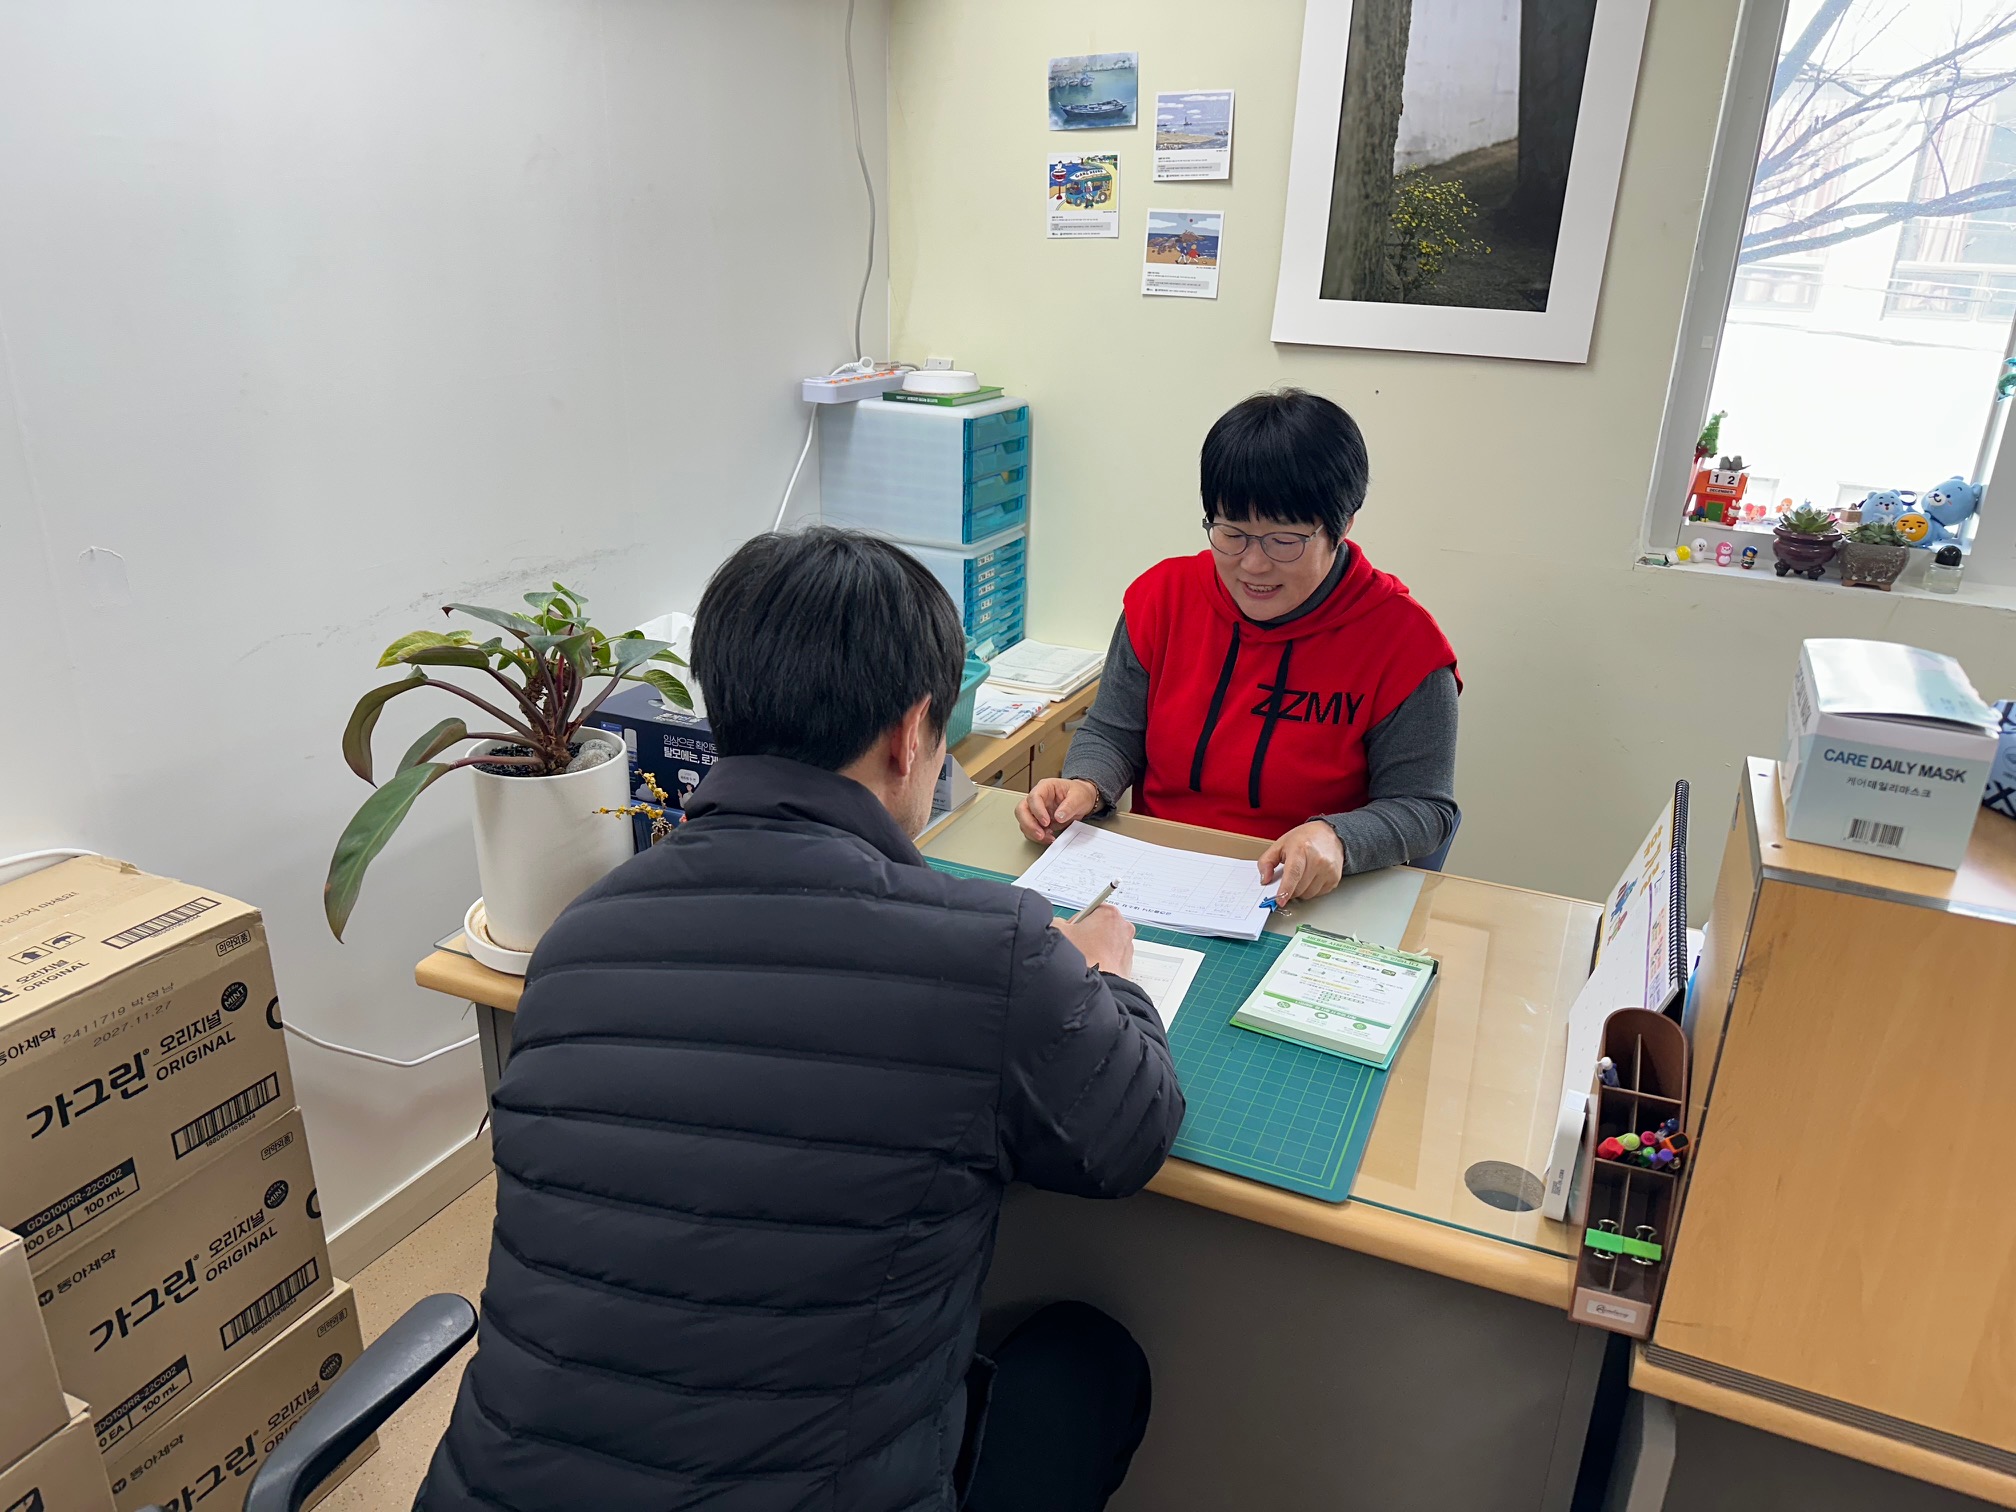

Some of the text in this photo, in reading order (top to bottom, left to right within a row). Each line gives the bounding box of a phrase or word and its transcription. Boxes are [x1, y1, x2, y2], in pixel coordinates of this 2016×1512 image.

[663, 734, 695, 750] 임상으로
[663, 746, 700, 764] 탈모에는,
[1823, 748, 1968, 784] CARE DAILY MASK
[16, 959, 70, 985] 오리지널
[23, 961, 90, 992] ORIGINAL
[224, 986, 244, 1008] MINT
[63, 1006, 126, 1045] 2411719
[93, 1000, 172, 1048] 2027.11.27
[160, 1009, 222, 1056] 오리지널
[156, 1030, 236, 1081] ORIGINAL
[26, 1051, 149, 1140] 가그린
[84, 1186, 125, 1216] 100 mL
[267, 1183, 286, 1206] MINT
[47, 1223, 65, 1240] EA
[208, 1208, 266, 1259] 오리지널
[57, 1248, 116, 1294] 동아제약
[205, 1226, 278, 1282] ORIGINAL
[89, 1258, 199, 1353] 가그린
[141, 1382, 179, 1413] 100 mL
[268, 1380, 320, 1432] 오리지널
[109, 1424, 125, 1441] EA
[129, 1433, 184, 1479] 동아제약
